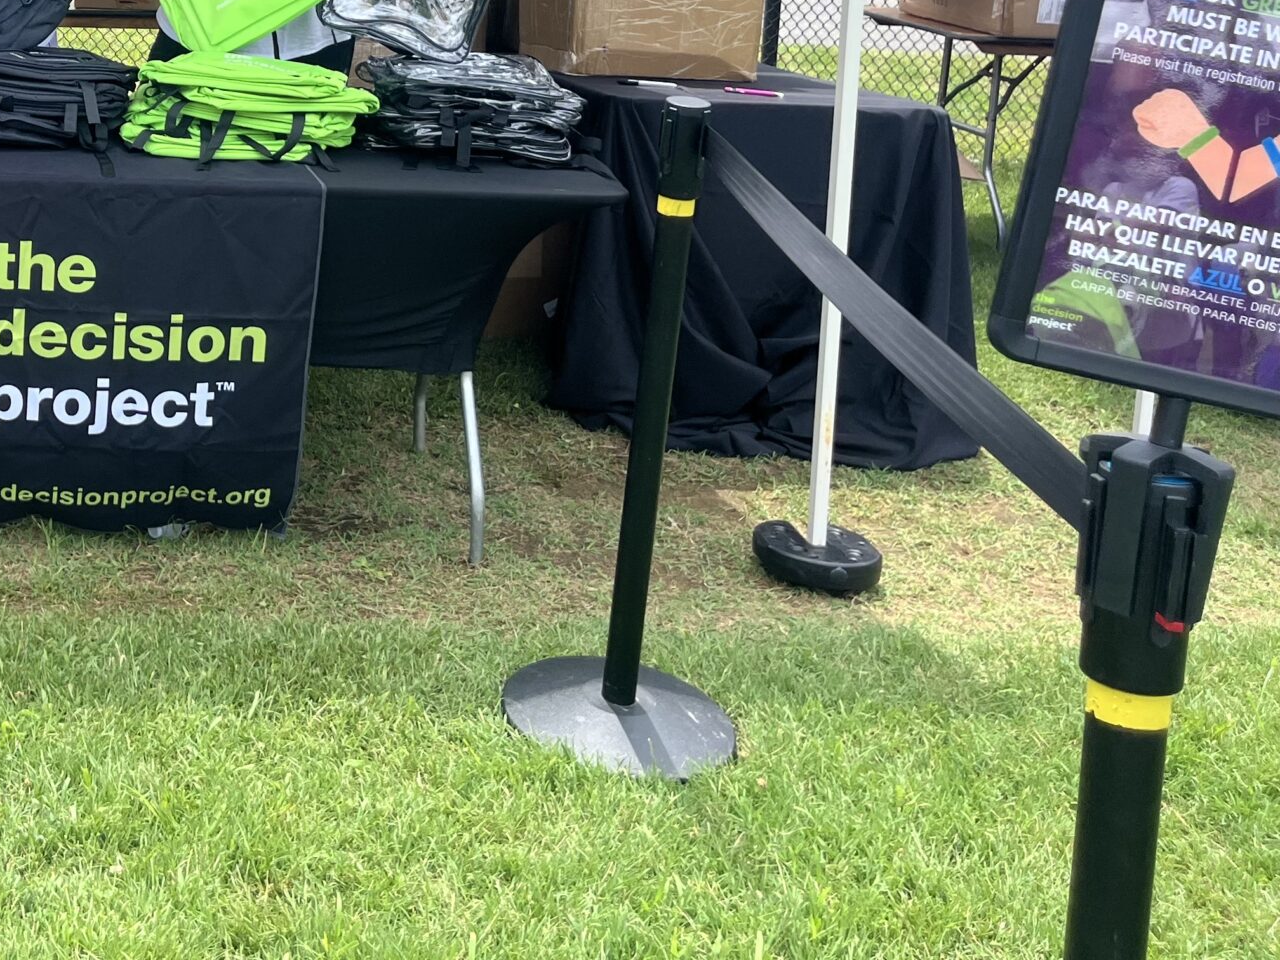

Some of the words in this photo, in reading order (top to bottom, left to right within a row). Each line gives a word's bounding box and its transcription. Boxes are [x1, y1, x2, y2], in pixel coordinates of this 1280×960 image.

[1113, 21, 1254, 64] PARTICIPATE
[1255, 49, 1280, 70] IN
[1166, 4, 1232, 32] MUST
[1233, 17, 1261, 38] BE
[1111, 46, 1152, 66] Please
[1155, 57, 1181, 72] visit
[1183, 60, 1203, 77] the
[1206, 66, 1276, 92] registration
[1055, 186, 1110, 214] PARA
[1114, 198, 1236, 240] PARTICIPAR
[1238, 226, 1268, 246] EN
[1064, 213, 1113, 238] HAY
[1114, 225, 1160, 247] QUE
[1161, 234, 1238, 266] LLEVAR
[1240, 251, 1280, 275] PUE
[1068, 238, 1187, 280] BRAZALETE
[1188, 266, 1246, 295] AZUL
[1247, 278, 1265, 296] O
[1032, 304, 1084, 322] decision
[1035, 292, 1056, 304] the
[1070, 279, 1114, 297] CARPA
[1117, 289, 1133, 301] DE
[1136, 292, 1201, 315] REGISTRO
[1203, 307, 1236, 324] PARA
[1238, 315, 1280, 333] REGIST
[1071, 262, 1085, 275] SI
[1086, 265, 1148, 288] NECESITA
[1151, 281, 1169, 293] UN
[1171, 284, 1247, 311] BRAZALETE,
[1250, 300, 1280, 317] DIRÍJ
[1028, 315, 1074, 332] project
